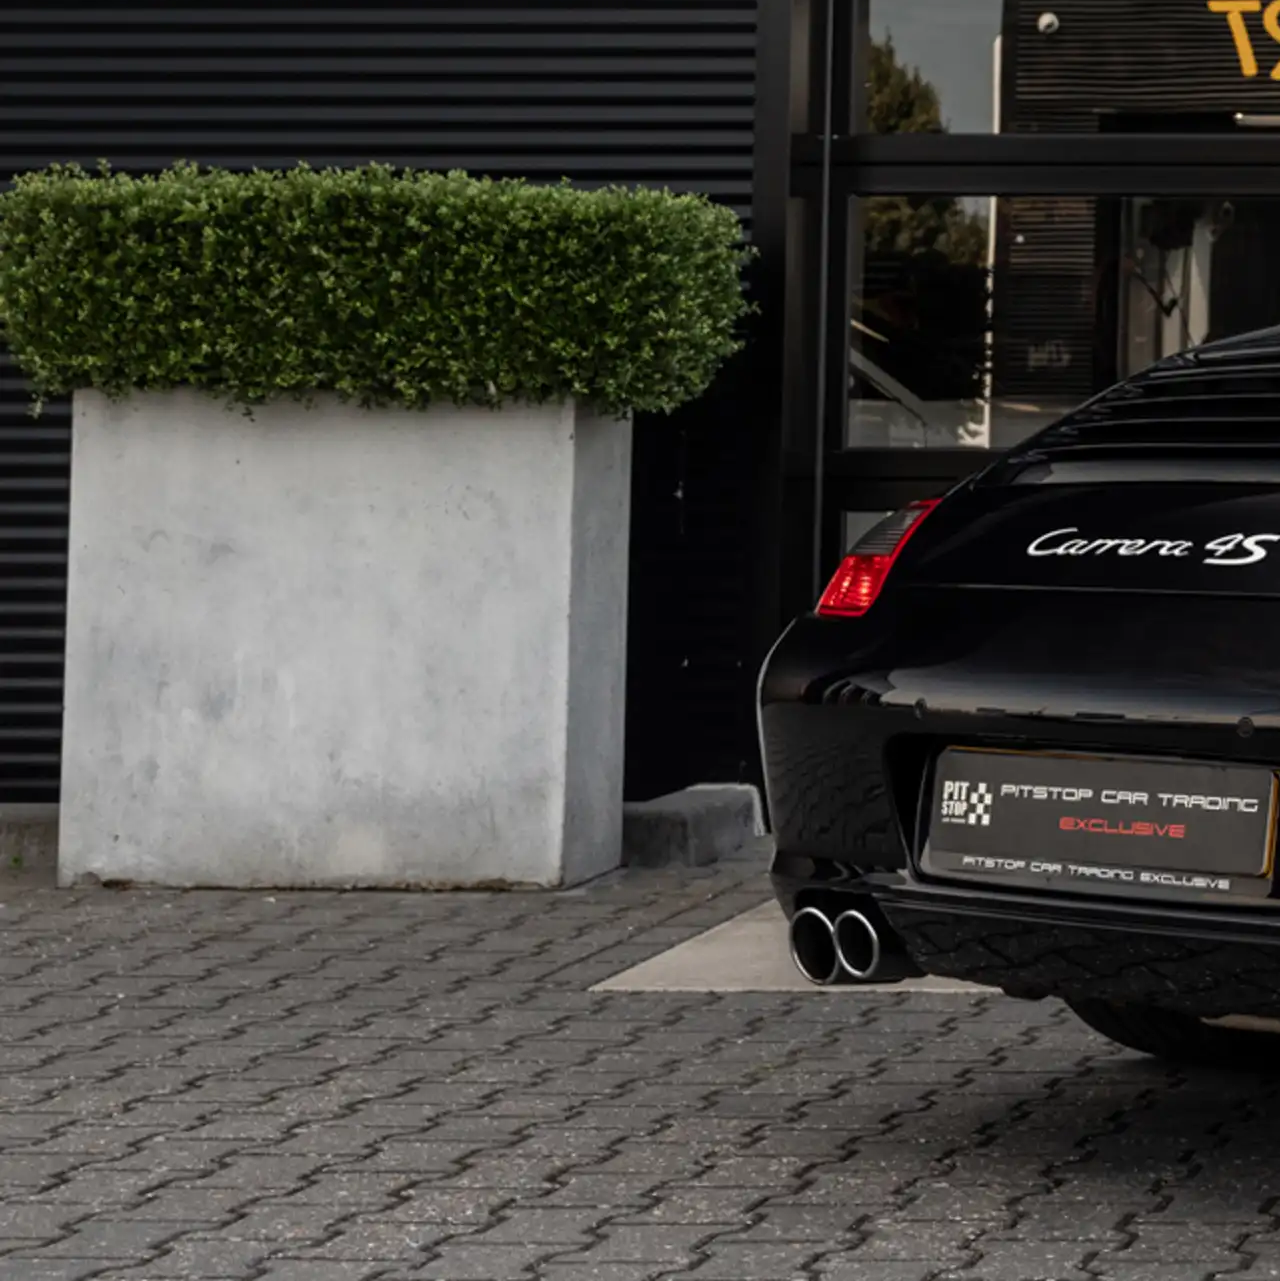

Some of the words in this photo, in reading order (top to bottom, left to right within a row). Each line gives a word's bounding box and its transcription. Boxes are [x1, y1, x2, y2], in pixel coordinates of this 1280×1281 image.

[1026, 527, 1194, 556] Carrera
[942, 780, 970, 801] PIT
[1000, 784, 1094, 801] PITSTOP
[1100, 789, 1149, 806] CAR
[1157, 793, 1259, 812] TRADING
[941, 801, 968, 816] STOP
[1058, 817, 1185, 838] EXCLUSIVE
[962, 855, 1026, 870] PITSTOP
[1030, 861, 1062, 874] CAR
[1139, 872, 1230, 890] EXCLUSIVE
